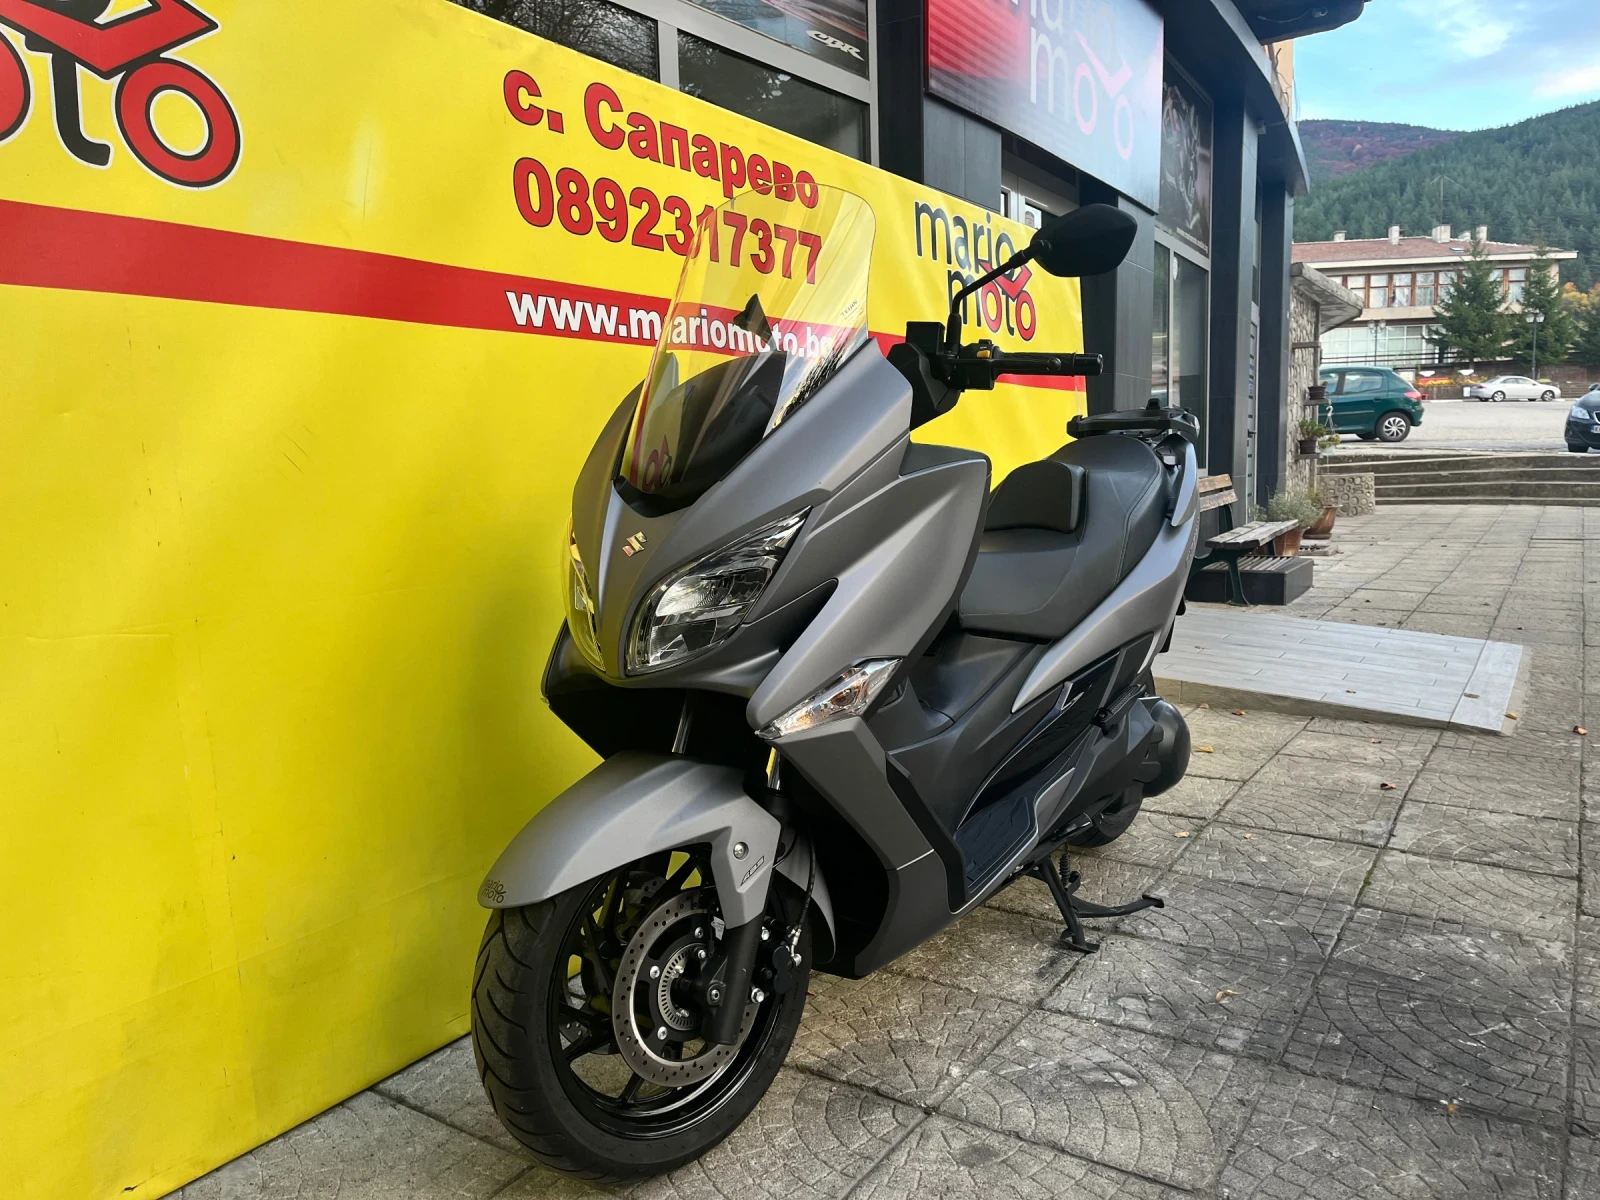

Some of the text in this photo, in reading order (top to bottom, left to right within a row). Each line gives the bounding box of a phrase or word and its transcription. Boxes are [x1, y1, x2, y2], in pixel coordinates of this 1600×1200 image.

[806, 30, 865, 61] CBR
[584, 82, 819, 209] Сапарево
[513, 157, 823, 285] 0892317377
[914, 201, 1017, 281] mario
[947, 269, 1037, 341] moto
